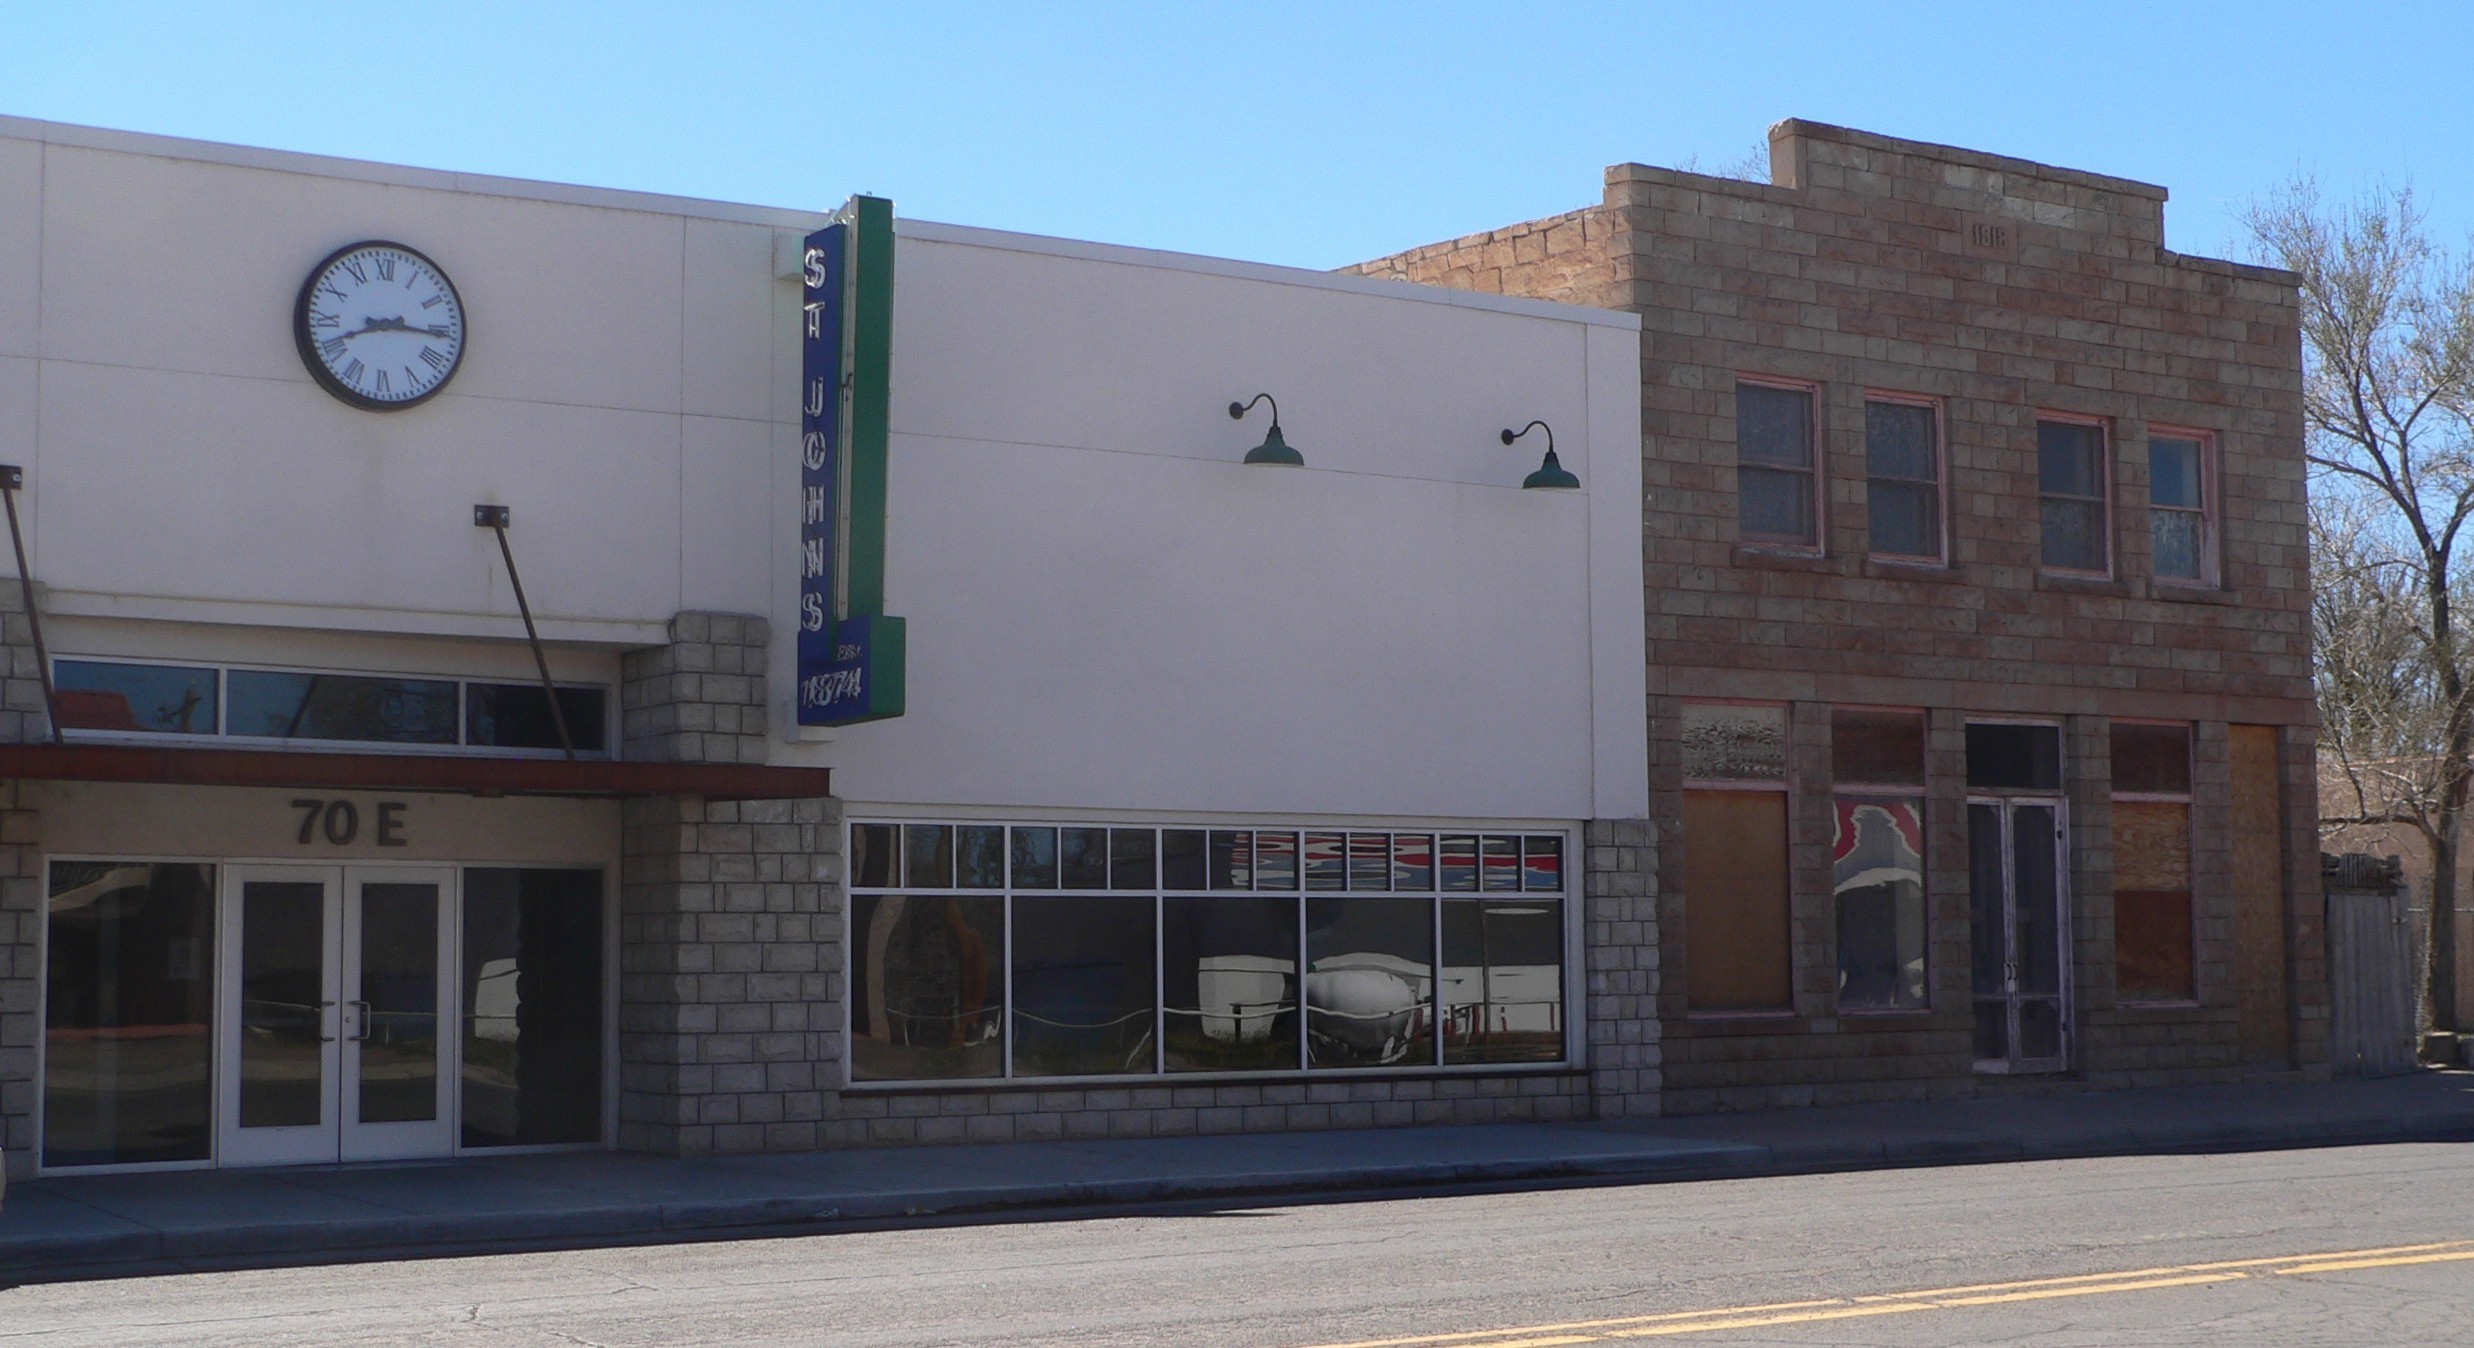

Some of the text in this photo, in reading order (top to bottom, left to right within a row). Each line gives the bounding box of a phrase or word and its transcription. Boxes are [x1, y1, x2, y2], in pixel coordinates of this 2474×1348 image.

[375, 258, 396, 281] XII
[802, 377, 827, 632] JOHNS
[801, 667, 863, 708] 1874
[291, 799, 408, 847] 70 E
